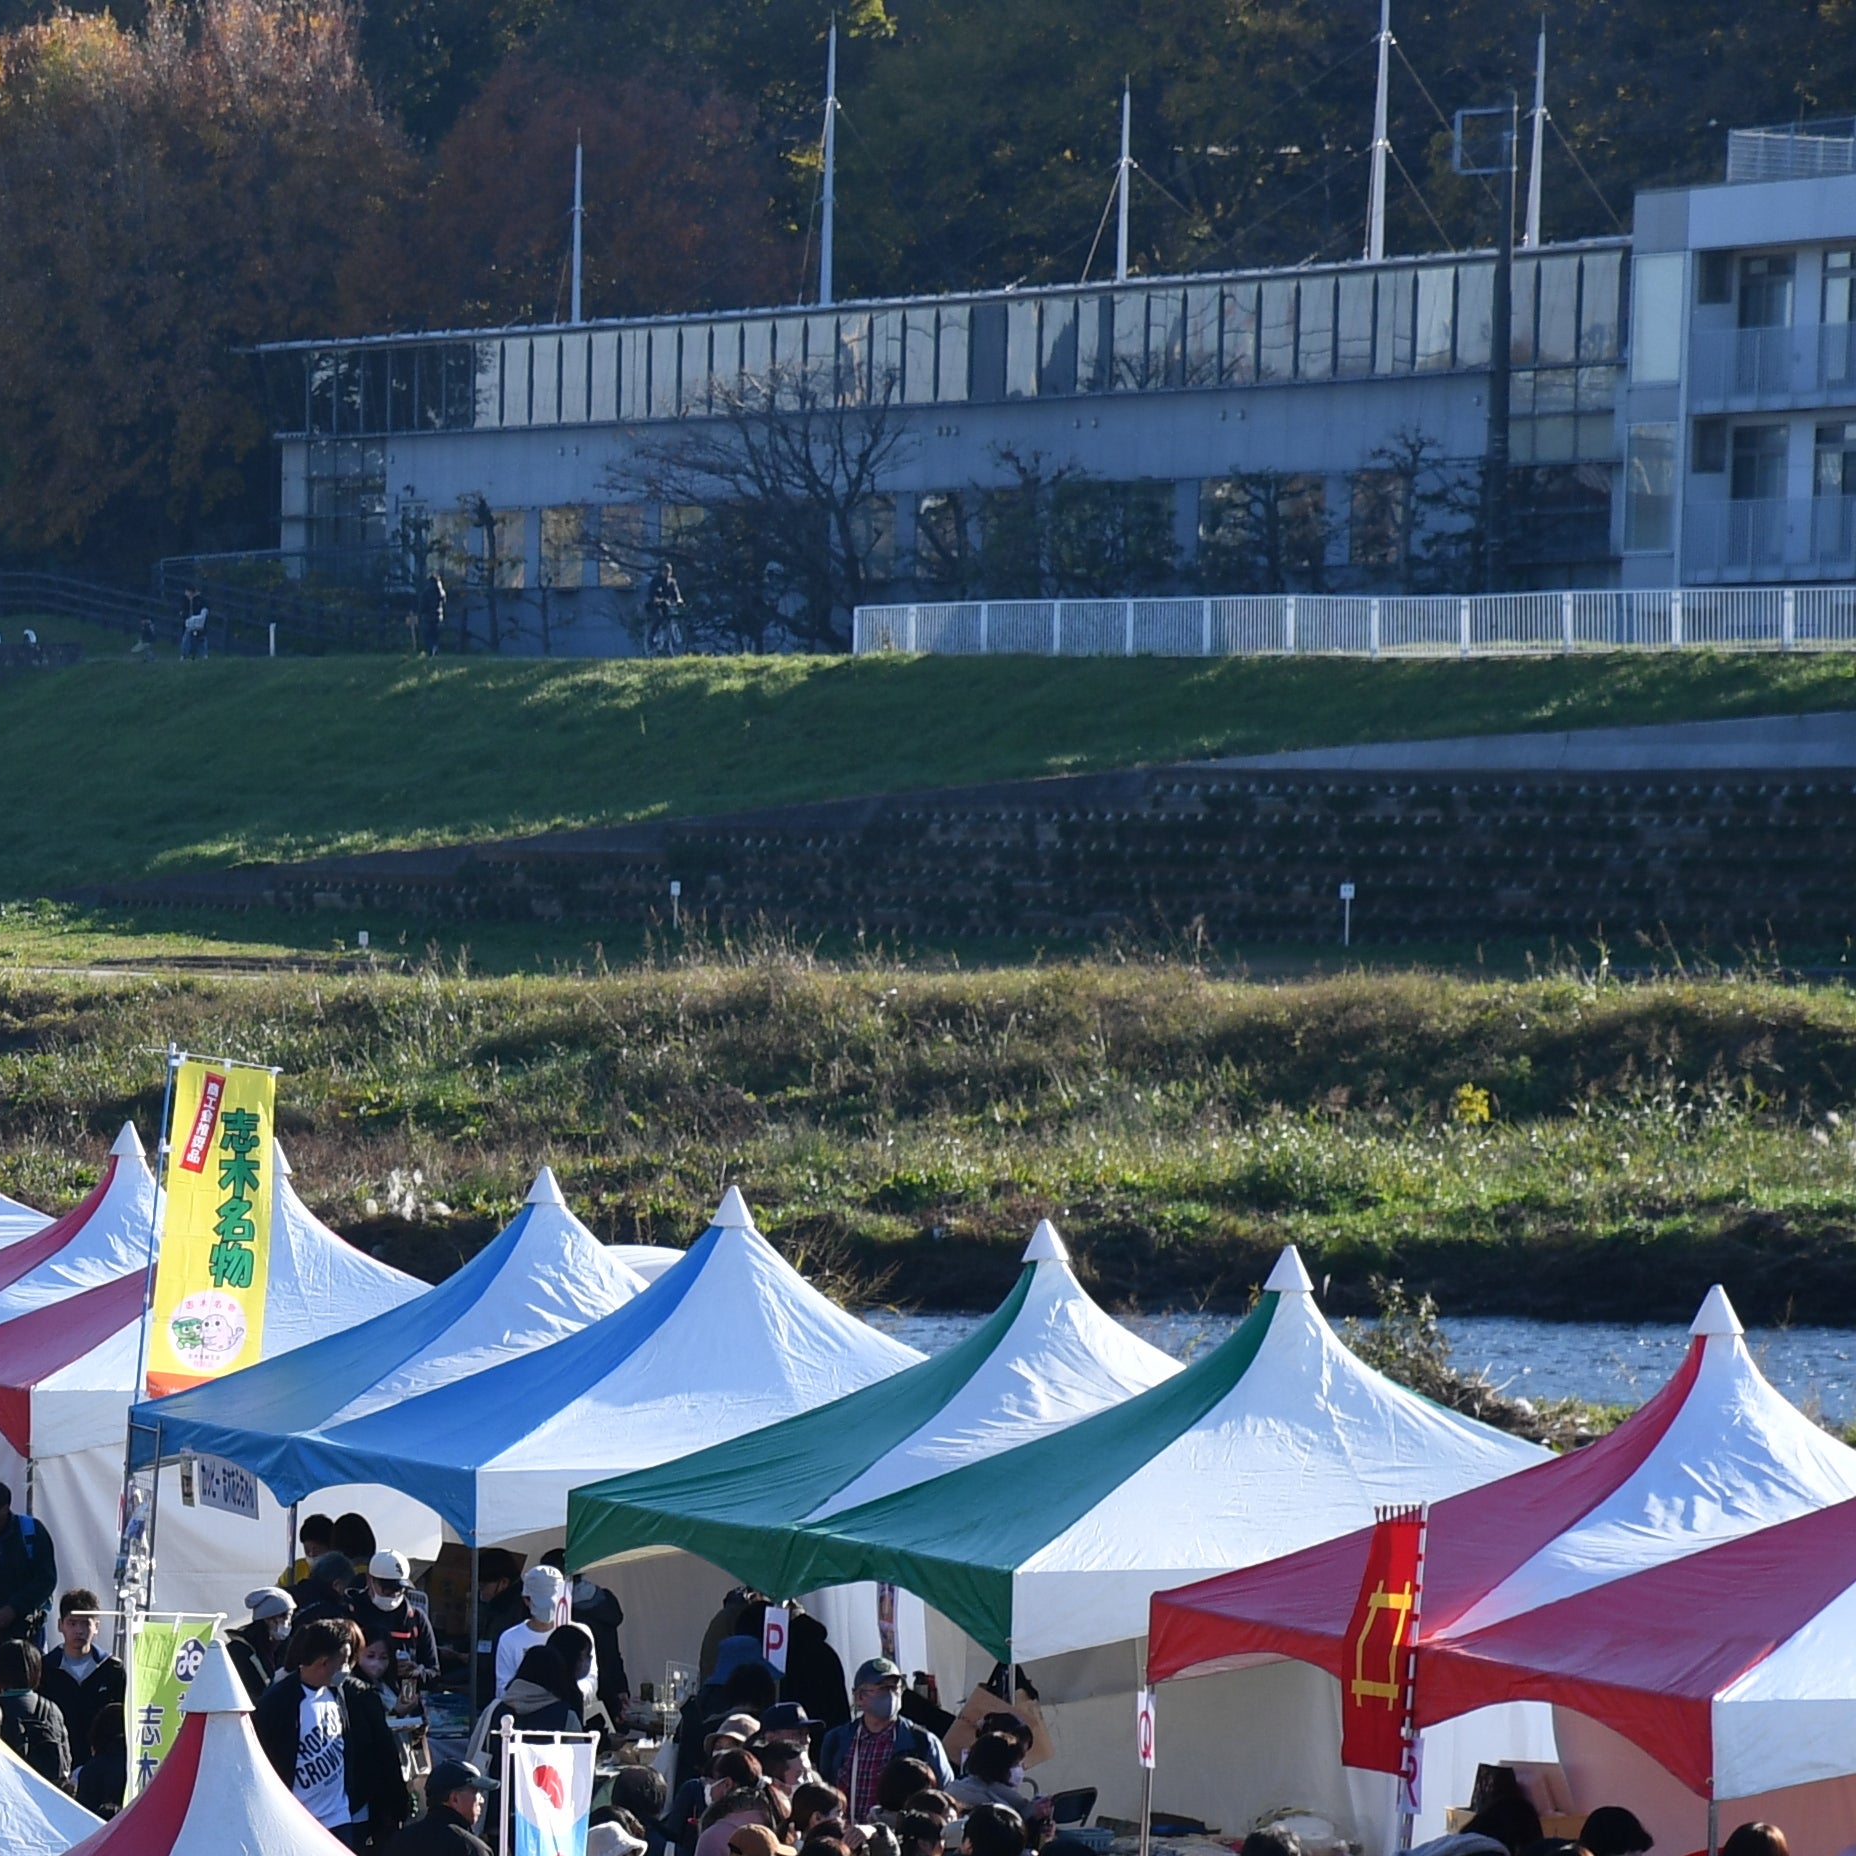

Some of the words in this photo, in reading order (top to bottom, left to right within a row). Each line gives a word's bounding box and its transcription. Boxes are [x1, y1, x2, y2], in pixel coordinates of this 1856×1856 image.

[209, 1107, 261, 1289] 志木名物
[766, 1623, 784, 1659] P
[1138, 1709, 1152, 1759] Q
